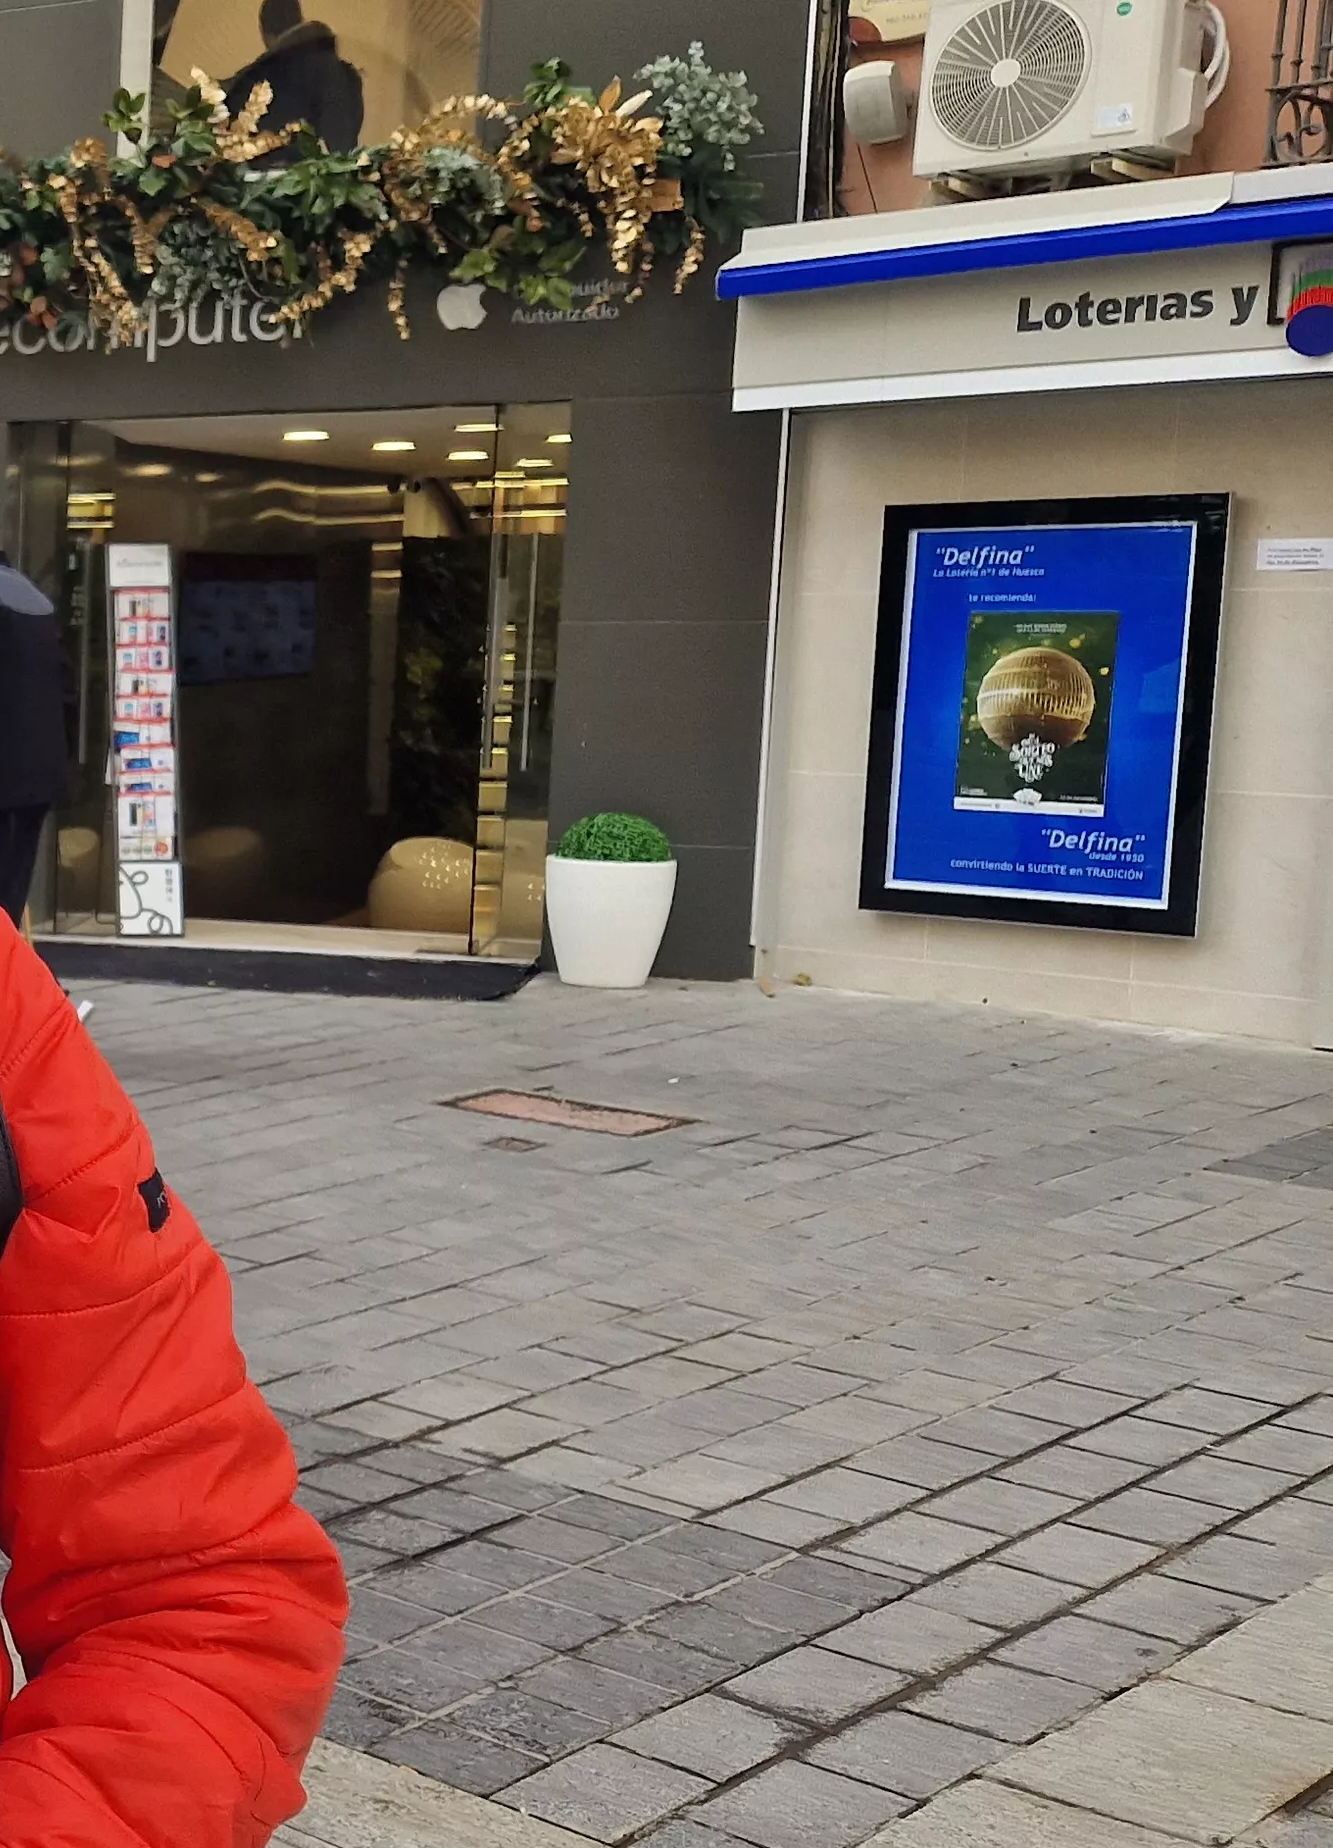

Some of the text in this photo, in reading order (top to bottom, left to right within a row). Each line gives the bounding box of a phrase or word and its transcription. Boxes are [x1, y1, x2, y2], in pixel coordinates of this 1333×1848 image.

[1229, 284, 1260, 327] y
[936, 545, 1035, 568] "Delfina"
[1041, 828, 1146, 855] "Delfina"
[1027, 862, 1067, 876] SUERTE
